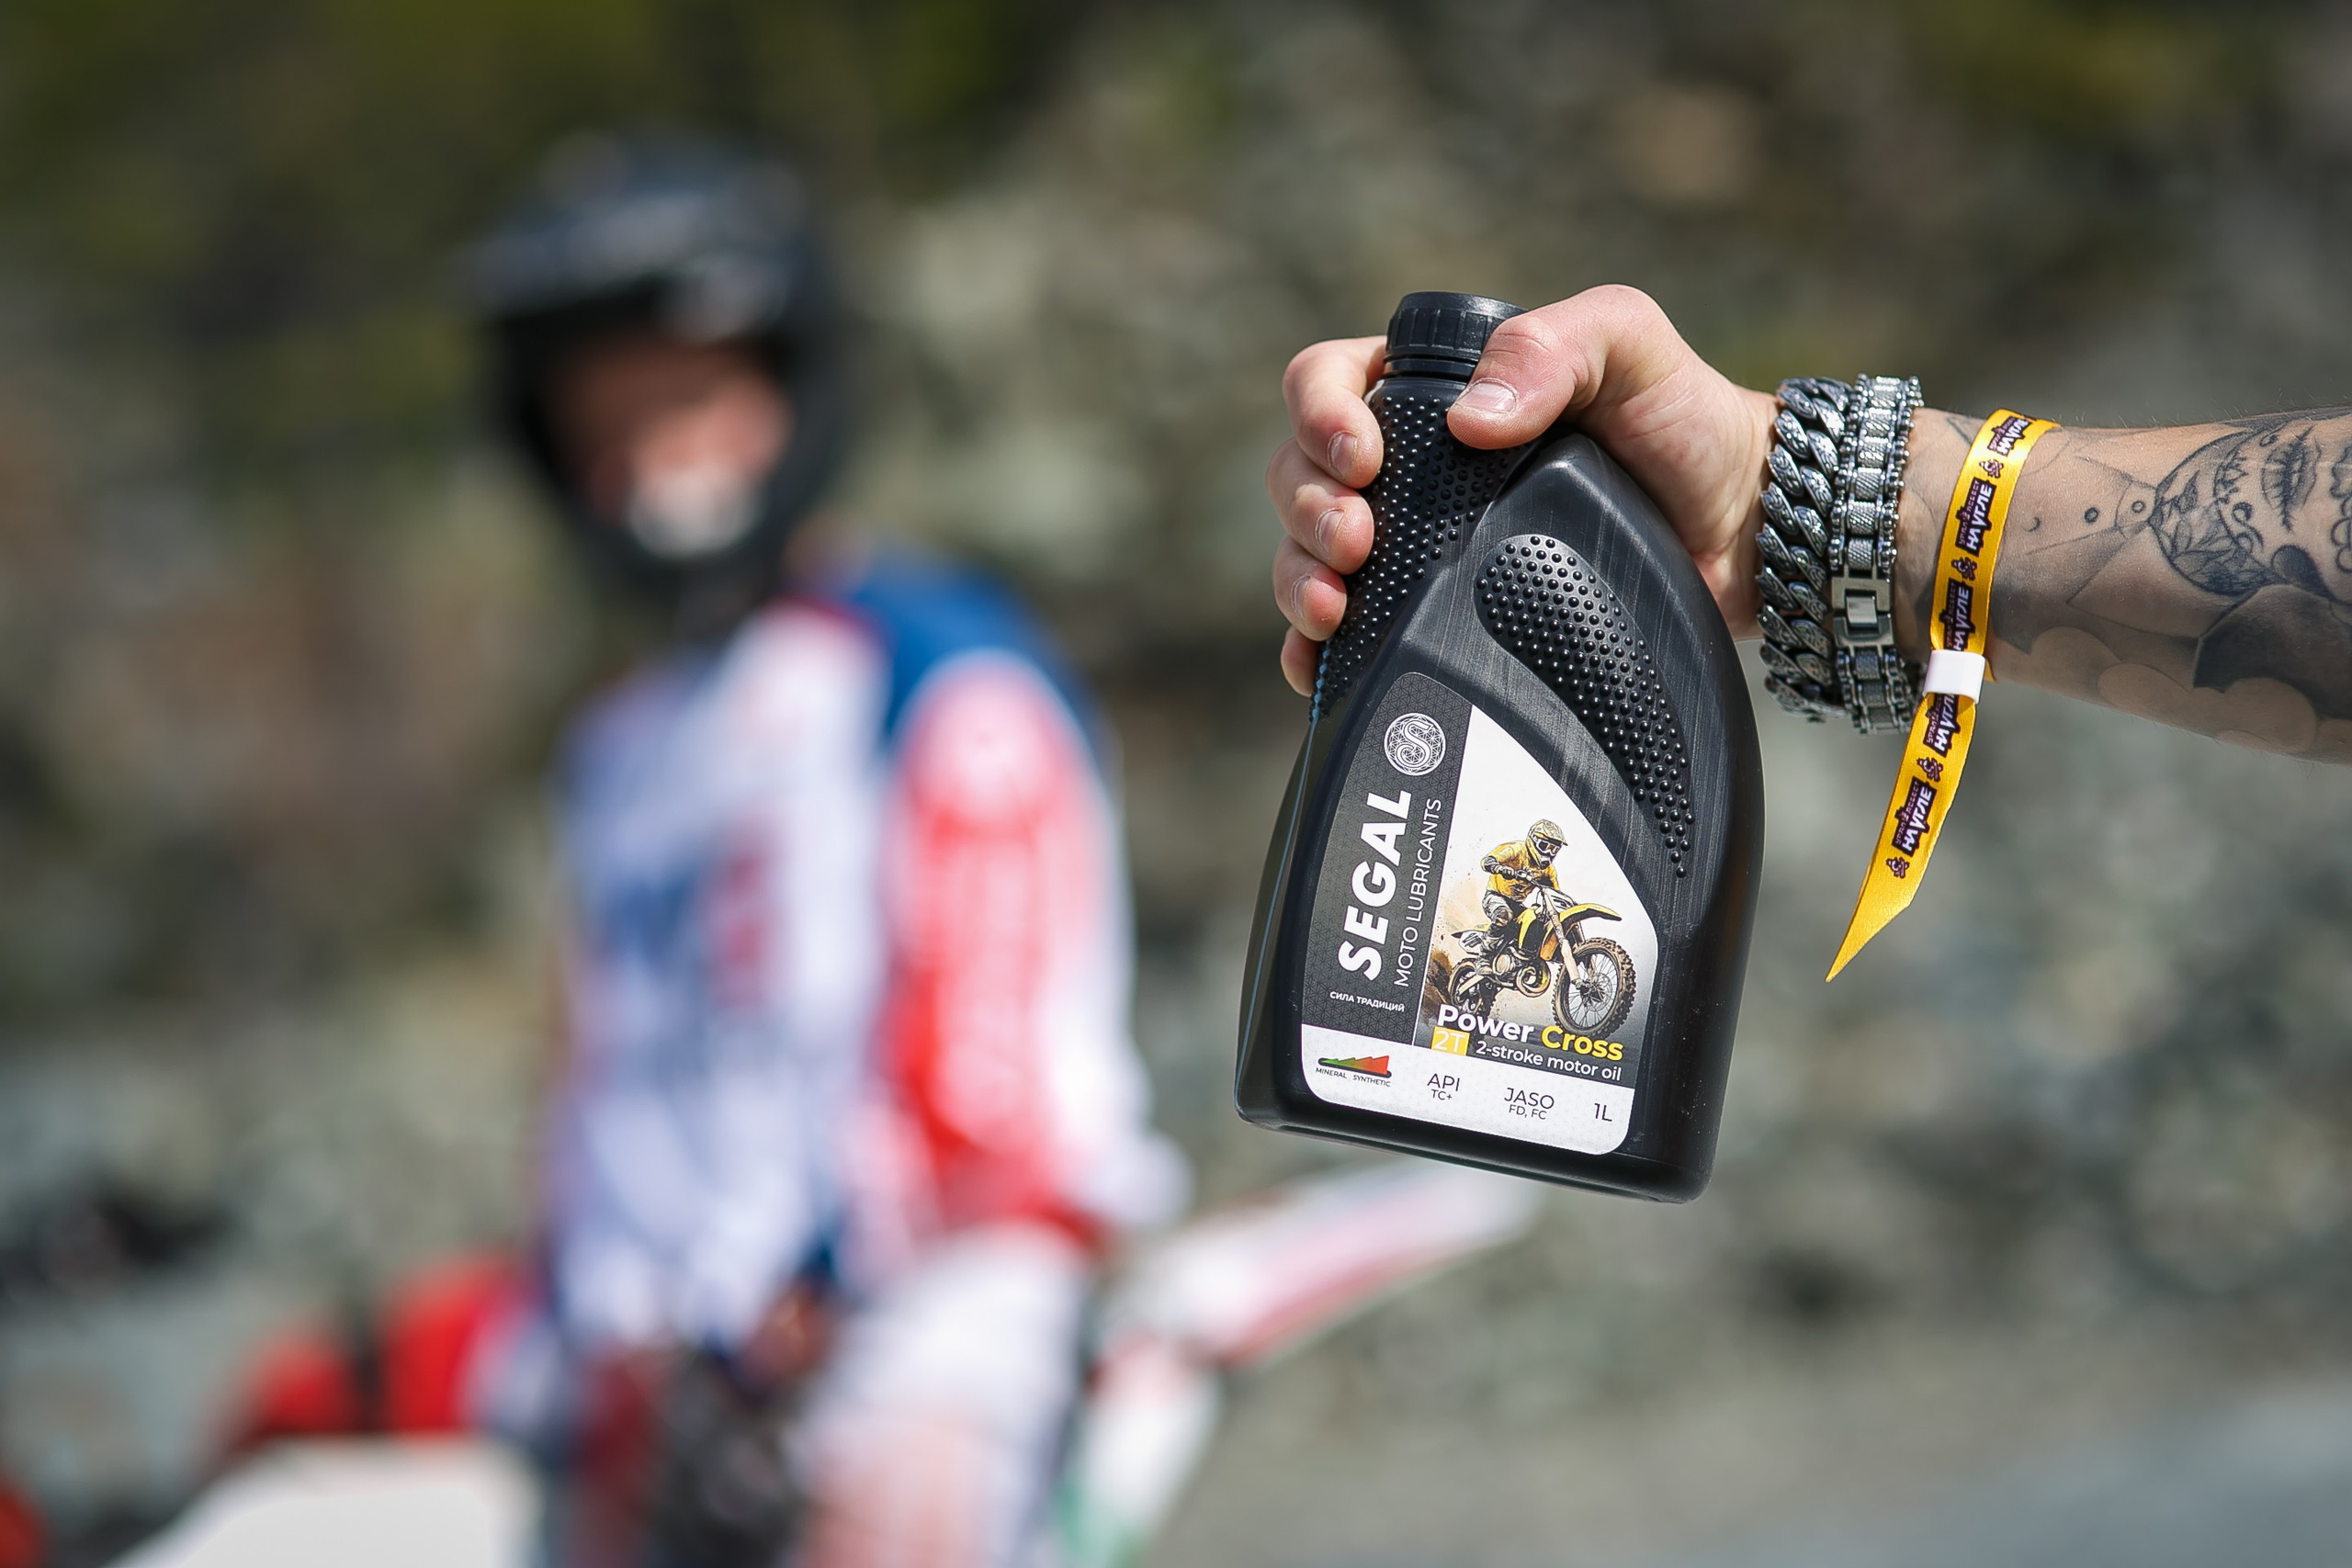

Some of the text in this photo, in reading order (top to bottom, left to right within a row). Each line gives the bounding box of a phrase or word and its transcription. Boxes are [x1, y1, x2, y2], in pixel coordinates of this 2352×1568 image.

[1940, 694, 1956, 729] УГЛ
[1338, 790, 1412, 981] SEGAL
[1394, 798, 1442, 987] MOTO LUBRICANTS
[1329, 991, 1406, 1012] СИЛА ТРАДИЦИЙ
[1437, 1003, 1623, 1062] Power Cross
[1433, 1029, 1623, 1082] 2T 2-stroke motor oil
[1316, 1066, 1391, 1088] MINERAL SYNTHETIC
[1427, 1073, 1461, 1092] API
[1430, 1089, 1453, 1100] TC+
[1504, 1087, 1555, 1110] JASO
[1509, 1104, 1547, 1121] FD, FC
[1594, 1102, 1612, 1122] 1L
